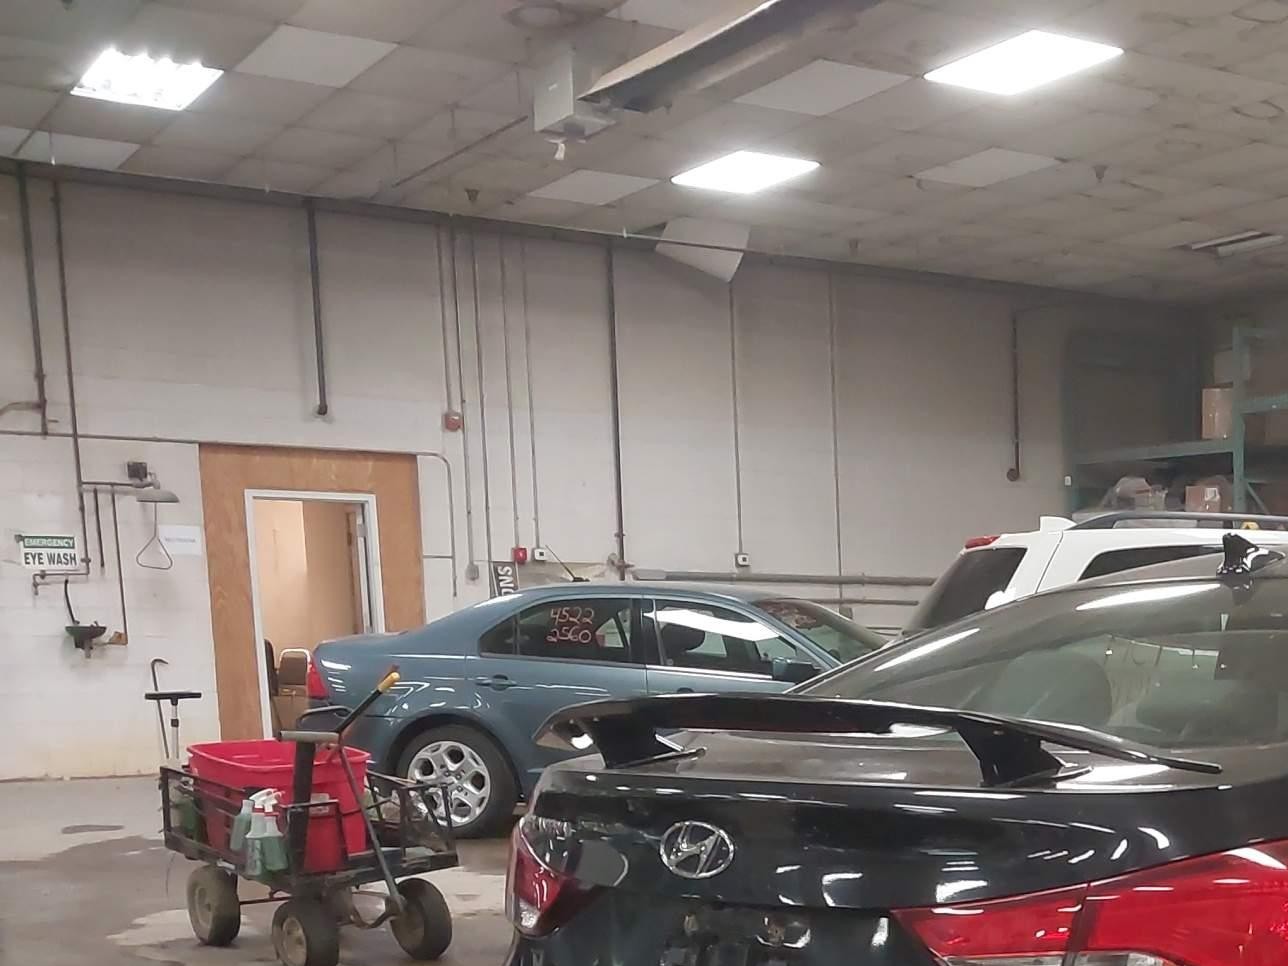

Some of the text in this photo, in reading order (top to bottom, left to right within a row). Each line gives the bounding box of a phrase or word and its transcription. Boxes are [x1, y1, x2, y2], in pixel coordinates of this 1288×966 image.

[24, 538, 73, 548] EMERGENCY
[24, 552, 77, 565] EYE WASH
[551, 606, 595, 625] 4522
[546, 626, 592, 643] 2560
